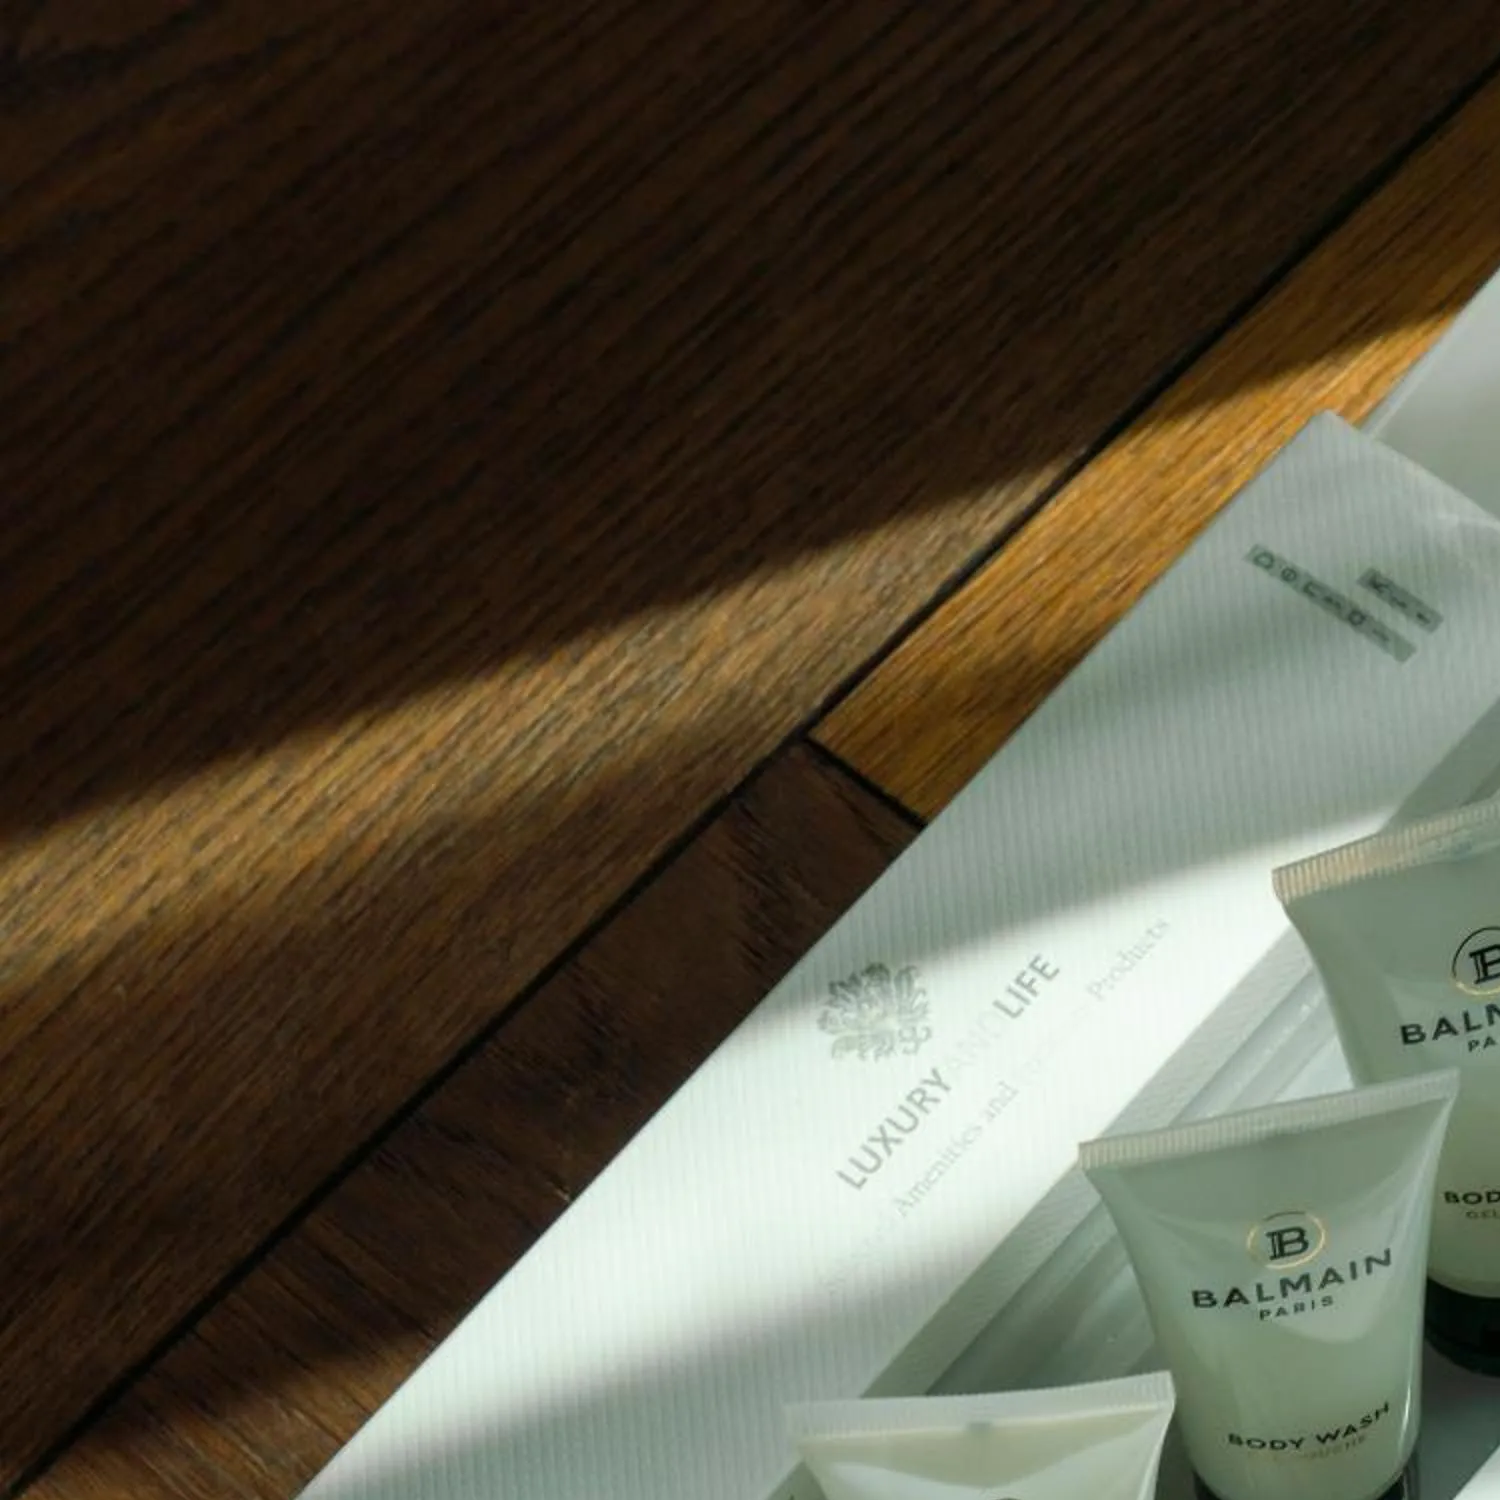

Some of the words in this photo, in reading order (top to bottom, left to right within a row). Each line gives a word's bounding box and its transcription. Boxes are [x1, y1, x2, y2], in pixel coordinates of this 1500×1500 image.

[835, 1067, 953, 1193] LUXURY
[992, 953, 1062, 1021] LIFE
[1191, 1247, 1392, 1309] BALMAIN
[1259, 1295, 1334, 1321] PARIS
[1227, 1431, 1305, 1451] BODY
[1315, 1401, 1390, 1444] WASH
